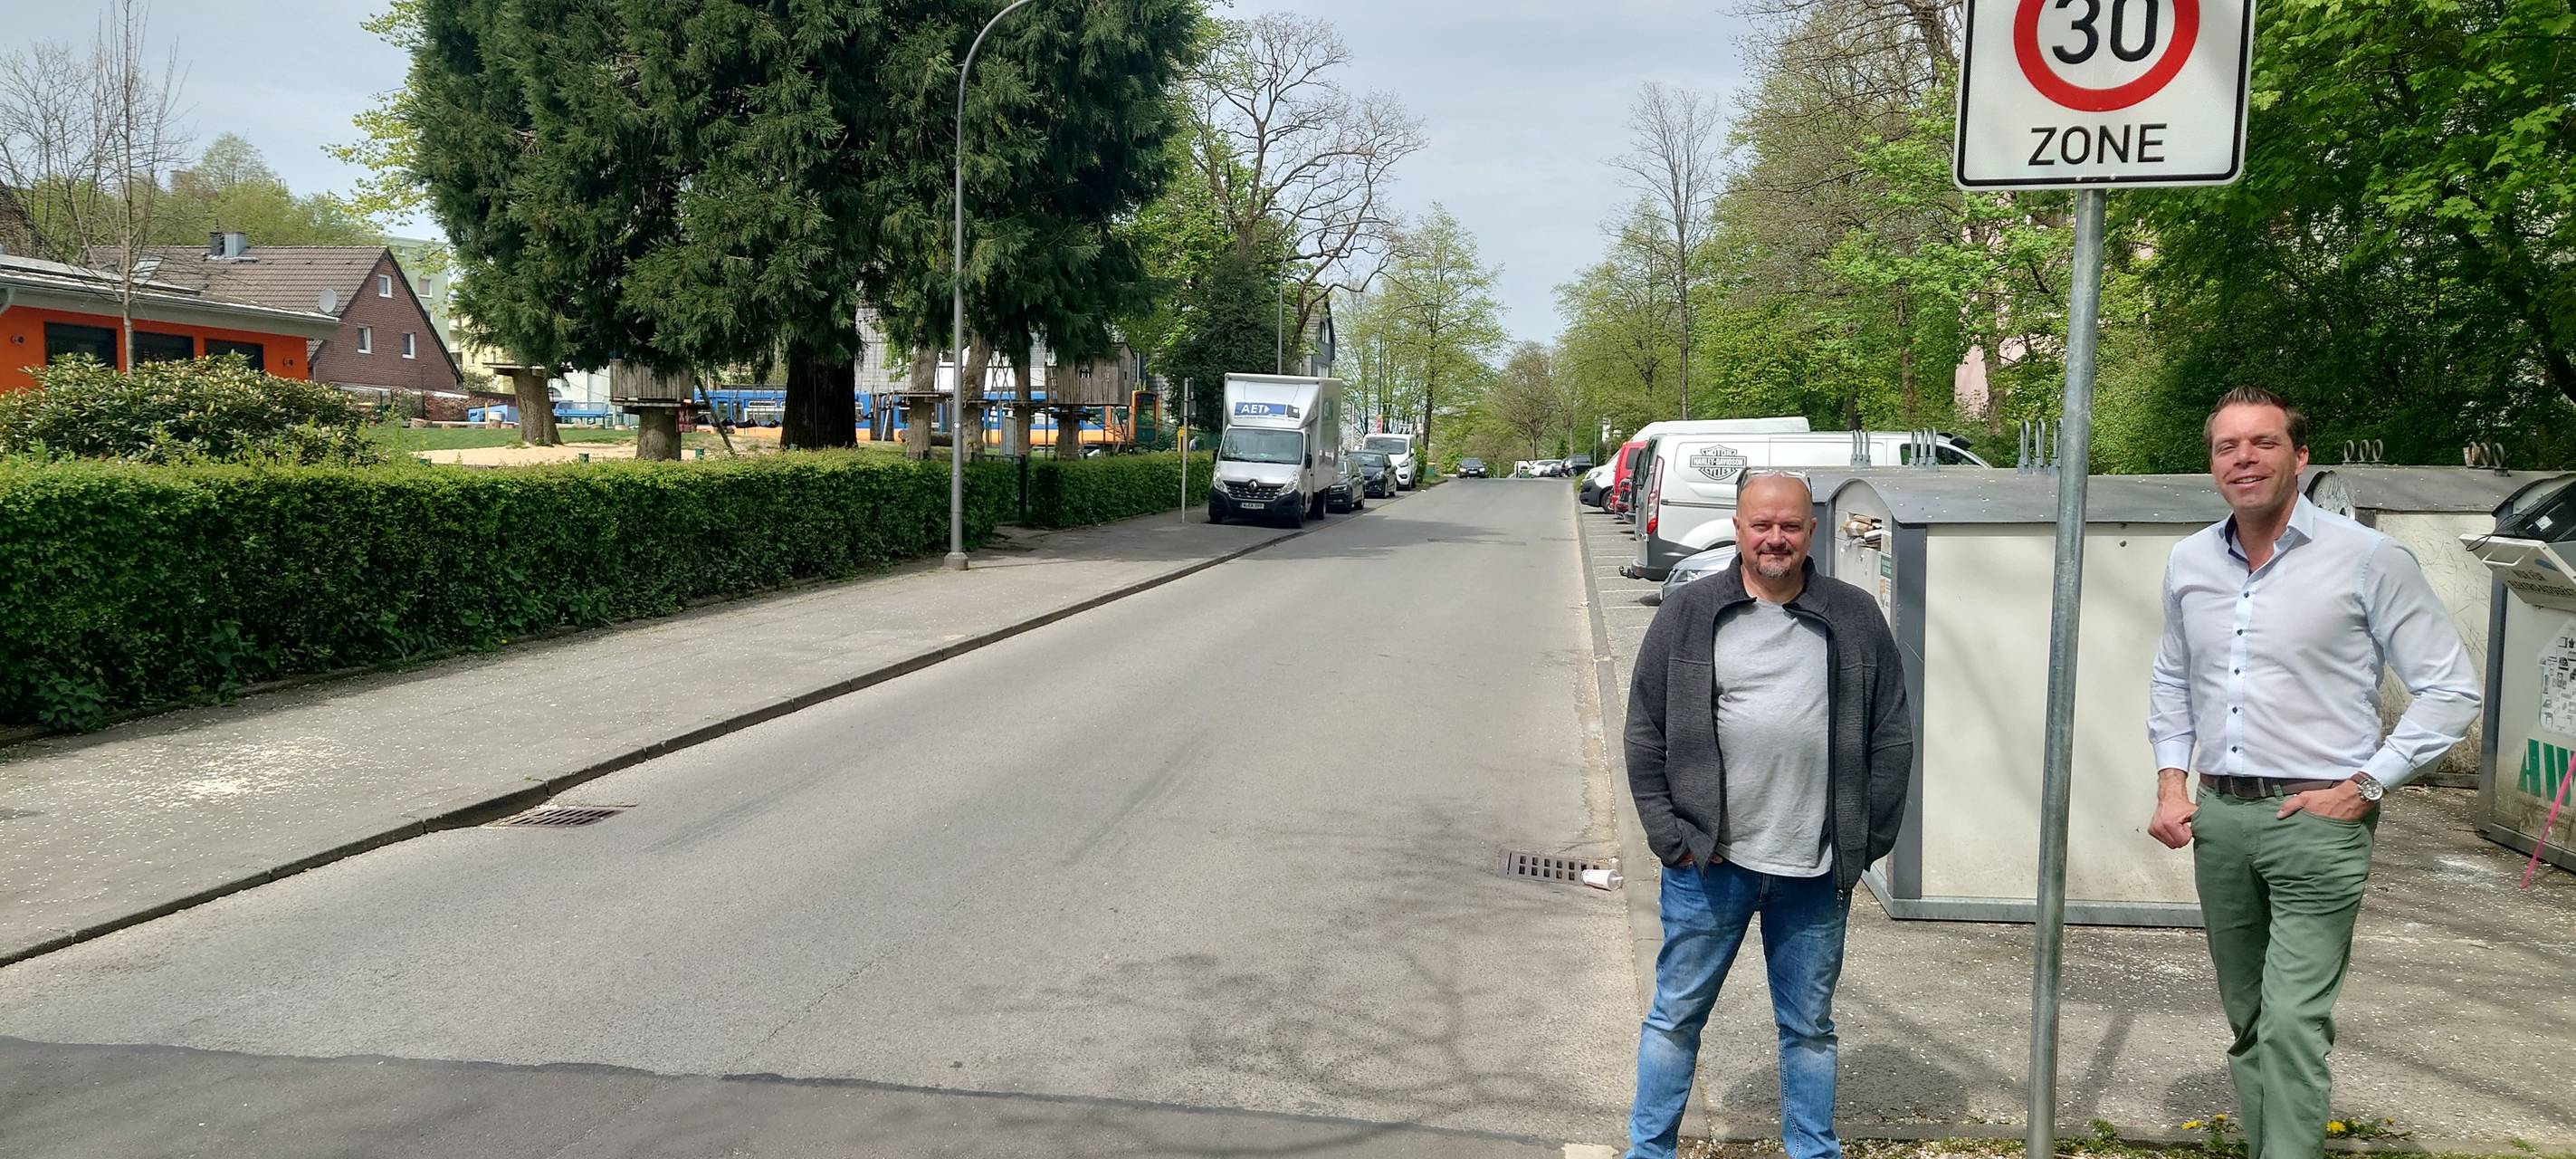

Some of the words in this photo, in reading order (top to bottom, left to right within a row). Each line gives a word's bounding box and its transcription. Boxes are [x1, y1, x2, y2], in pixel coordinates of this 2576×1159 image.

[2051, 0, 2159, 64] 30
[2027, 123, 2167, 167] ZONE
[1692, 457, 1744, 466] HARLEY-DAVIDSON
